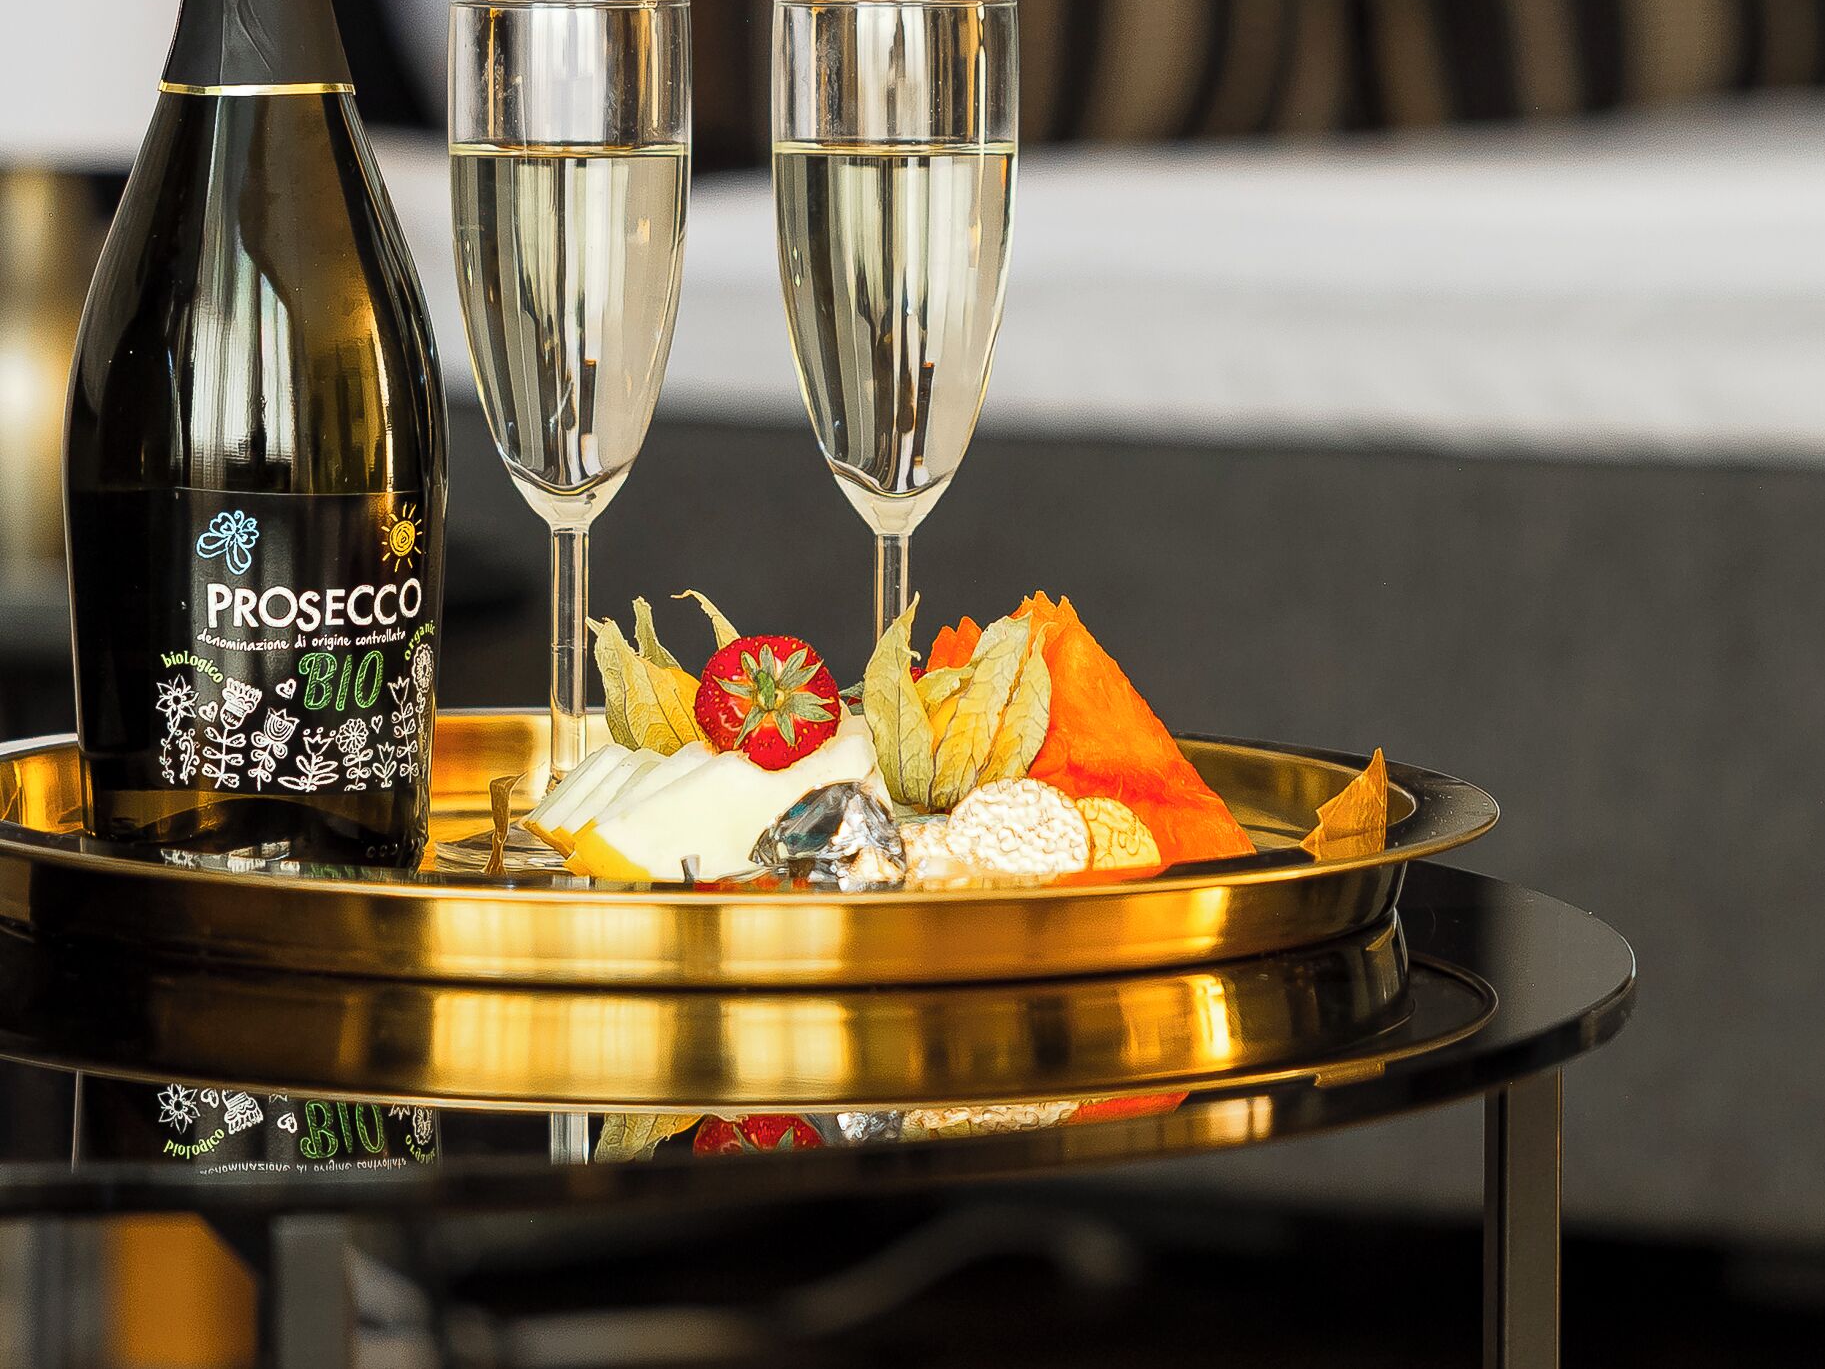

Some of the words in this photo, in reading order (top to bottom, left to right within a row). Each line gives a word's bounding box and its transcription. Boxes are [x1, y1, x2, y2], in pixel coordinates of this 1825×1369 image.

[207, 578, 421, 631] PROSECCO
[197, 628, 290, 651] denominazione
[294, 634, 307, 649] di
[312, 634, 352, 650] origine
[356, 627, 406, 646] controllata
[161, 651, 224, 683] biologico
[299, 651, 384, 711] BIO
